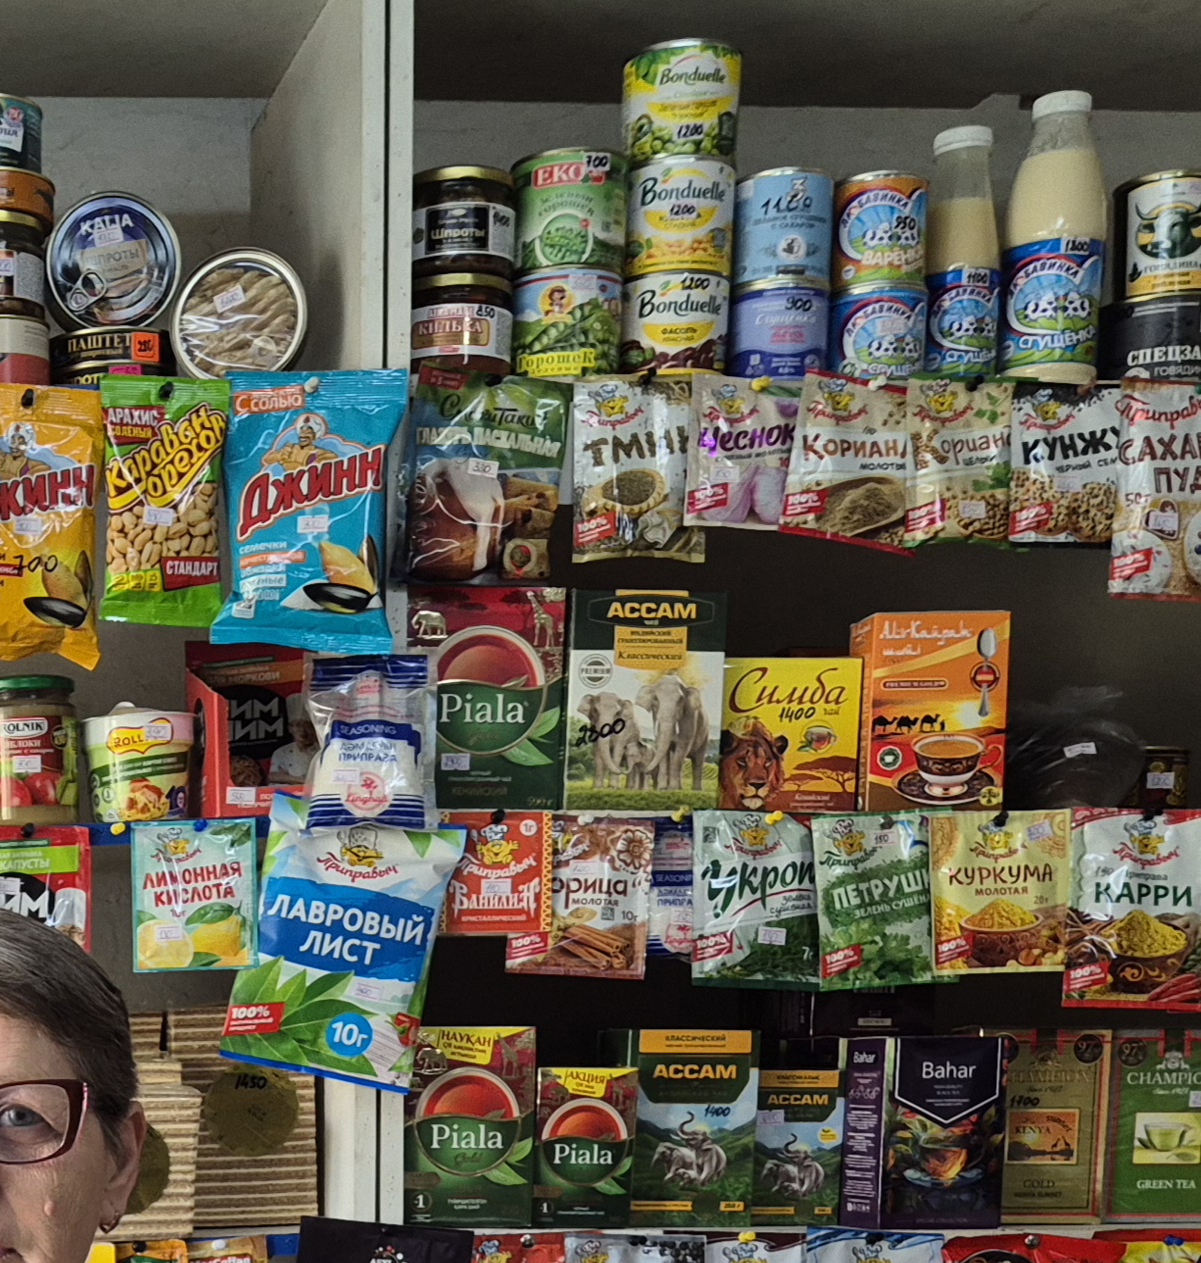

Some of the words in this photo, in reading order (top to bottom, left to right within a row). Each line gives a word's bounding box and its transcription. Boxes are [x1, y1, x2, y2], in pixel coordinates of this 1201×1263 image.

[660, 64, 726, 86] Bonduelle
[640, 178, 727, 207] Bonduelle
[637, 291, 723, 318] Bonduelle
[106, 407, 159, 428] АРАХИС
[239, 447, 382, 537] ДЖИНН
[164, 558, 219, 578] СТАНДАРТ
[728, 667, 849, 714] Симба
[439, 693, 526, 725] Piala
[778, 706, 816, 723] 1400
[340, 723, 397, 735] SEASONING
[142, 861, 243, 891] ЛИМОННАЯ
[948, 863, 1054, 886] КУРКУМА
[153, 883, 236, 908] КИСЛОТА
[552, 876, 629, 909] орица
[571, 897, 620, 907] МОЛОТАЯ
[974, 886, 1029, 897] МОЛОТАЯ
[1094, 882, 1194, 908] КАРРИ
[267, 893, 426, 947] ЛАВРОВЫЙ
[299, 930, 381, 966] ЛИСТ
[230, 1005, 271, 1019] 100%
[331, 1021, 370, 1048] 10г
[921, 1060, 978, 1082] Bahar
[430, 1123, 505, 1150] Piala
[553, 1143, 614, 1166] Piala
[1136, 1179, 1169, 1190] GREEN
[1171, 1178, 1197, 1190] TEA
